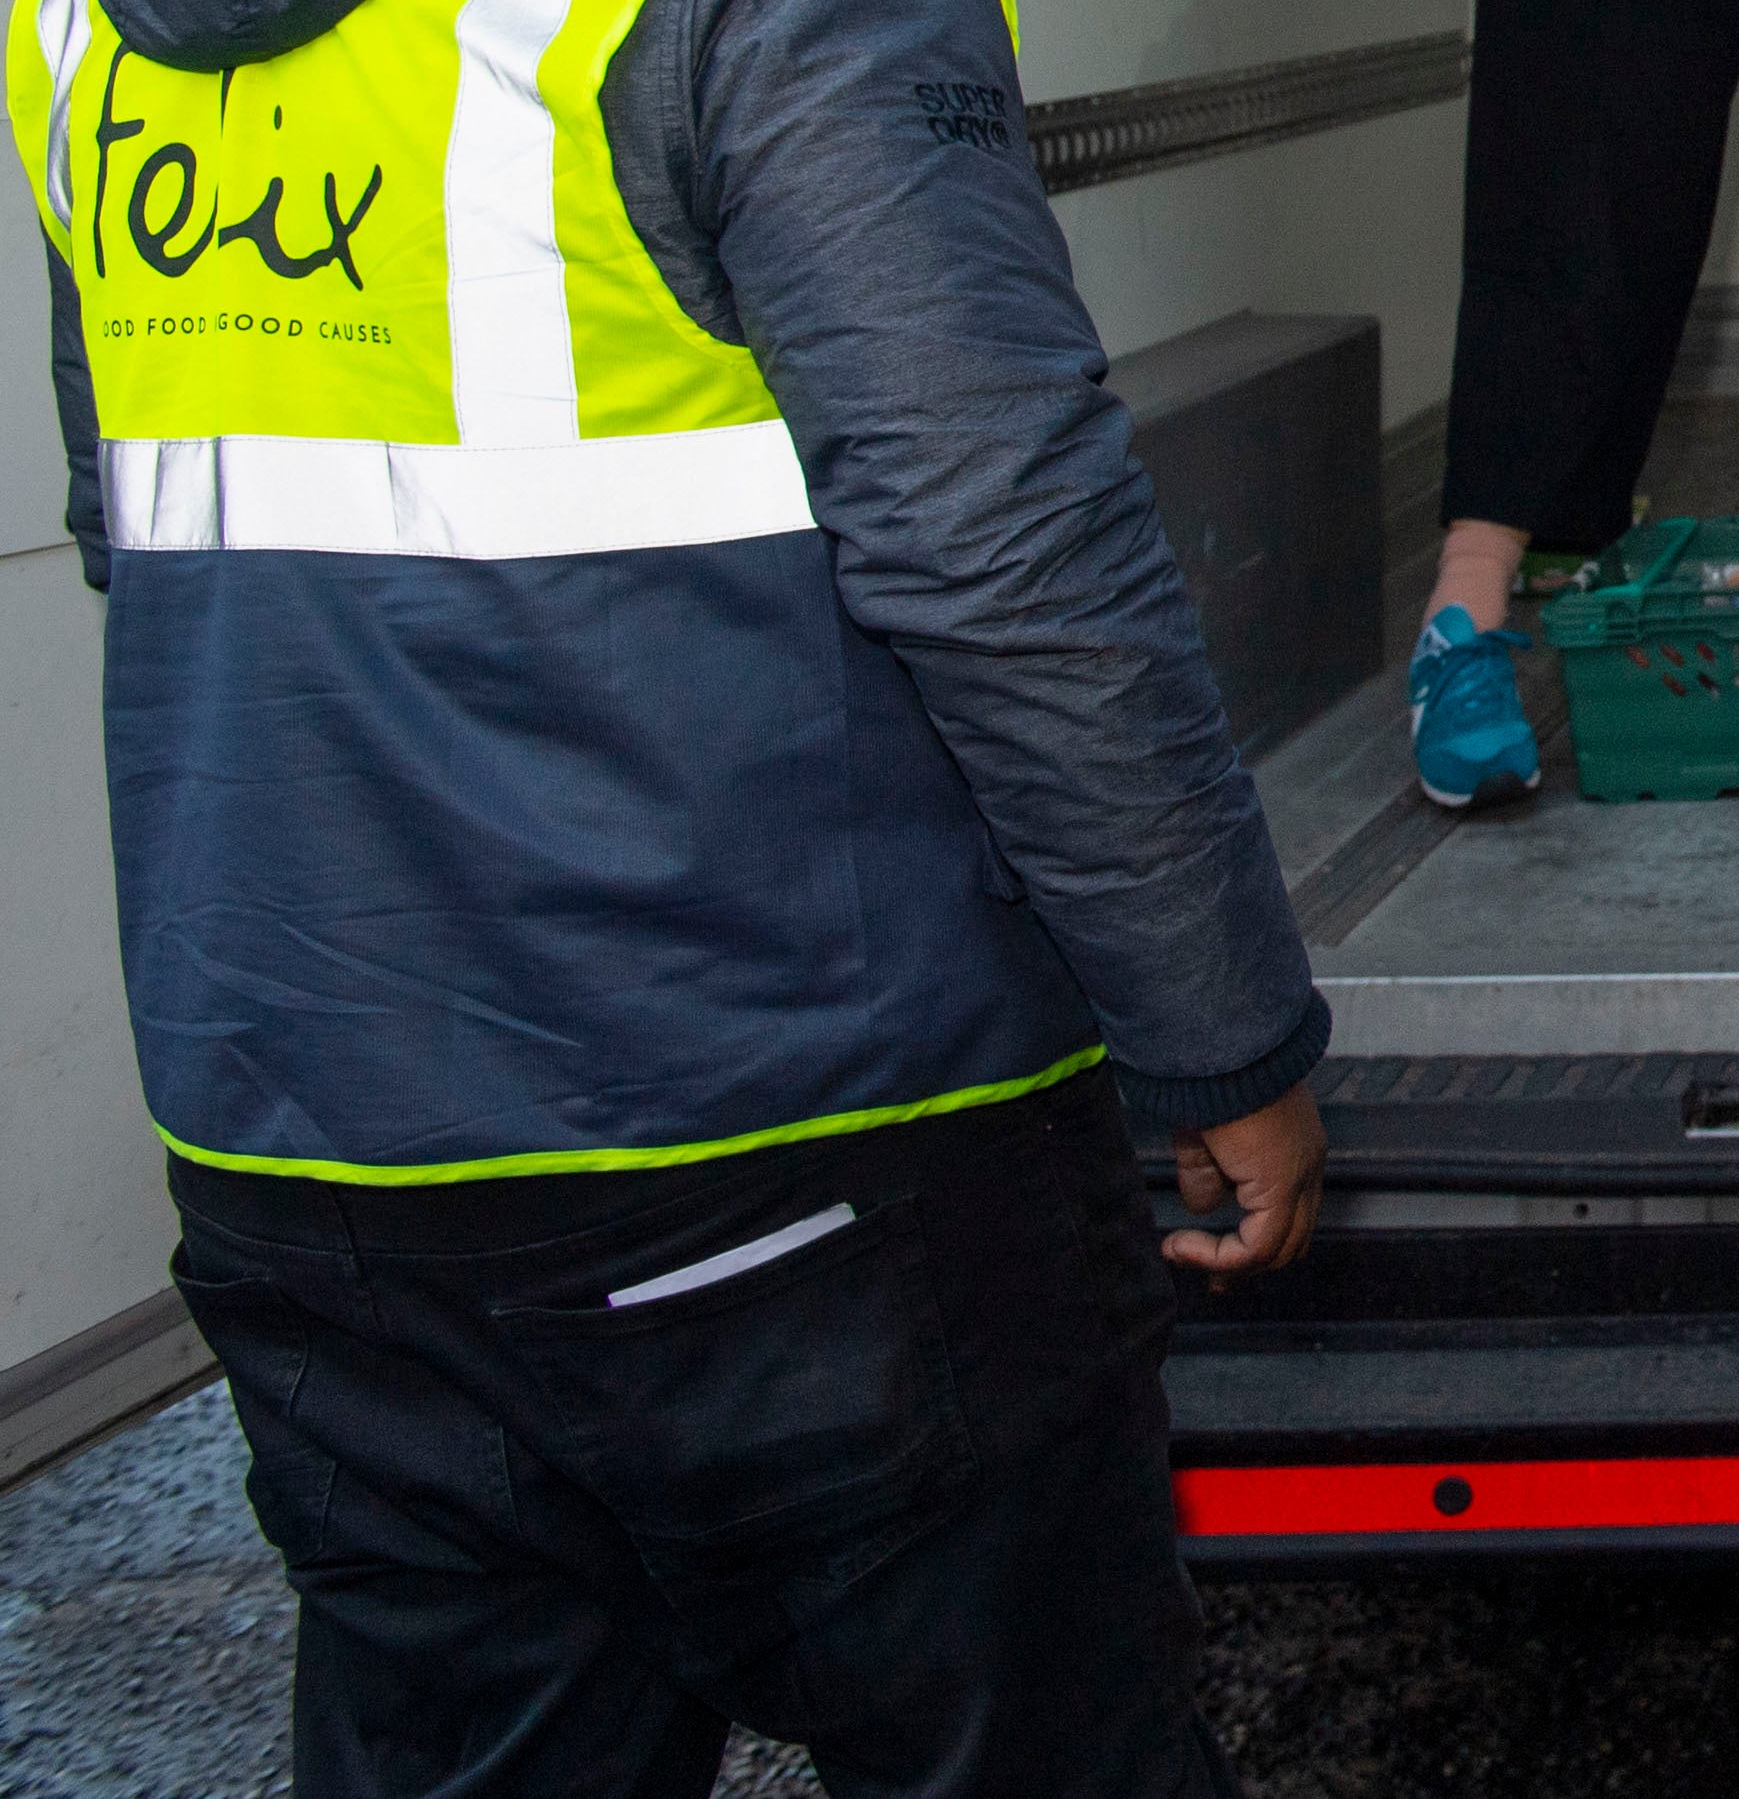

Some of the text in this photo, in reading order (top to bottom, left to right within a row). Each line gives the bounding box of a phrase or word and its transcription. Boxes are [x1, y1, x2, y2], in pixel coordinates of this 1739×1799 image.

[147, 316, 207, 336] FOOD
[217, 312, 303, 338] GOOD
[319, 314, 392, 344] CAUSES
